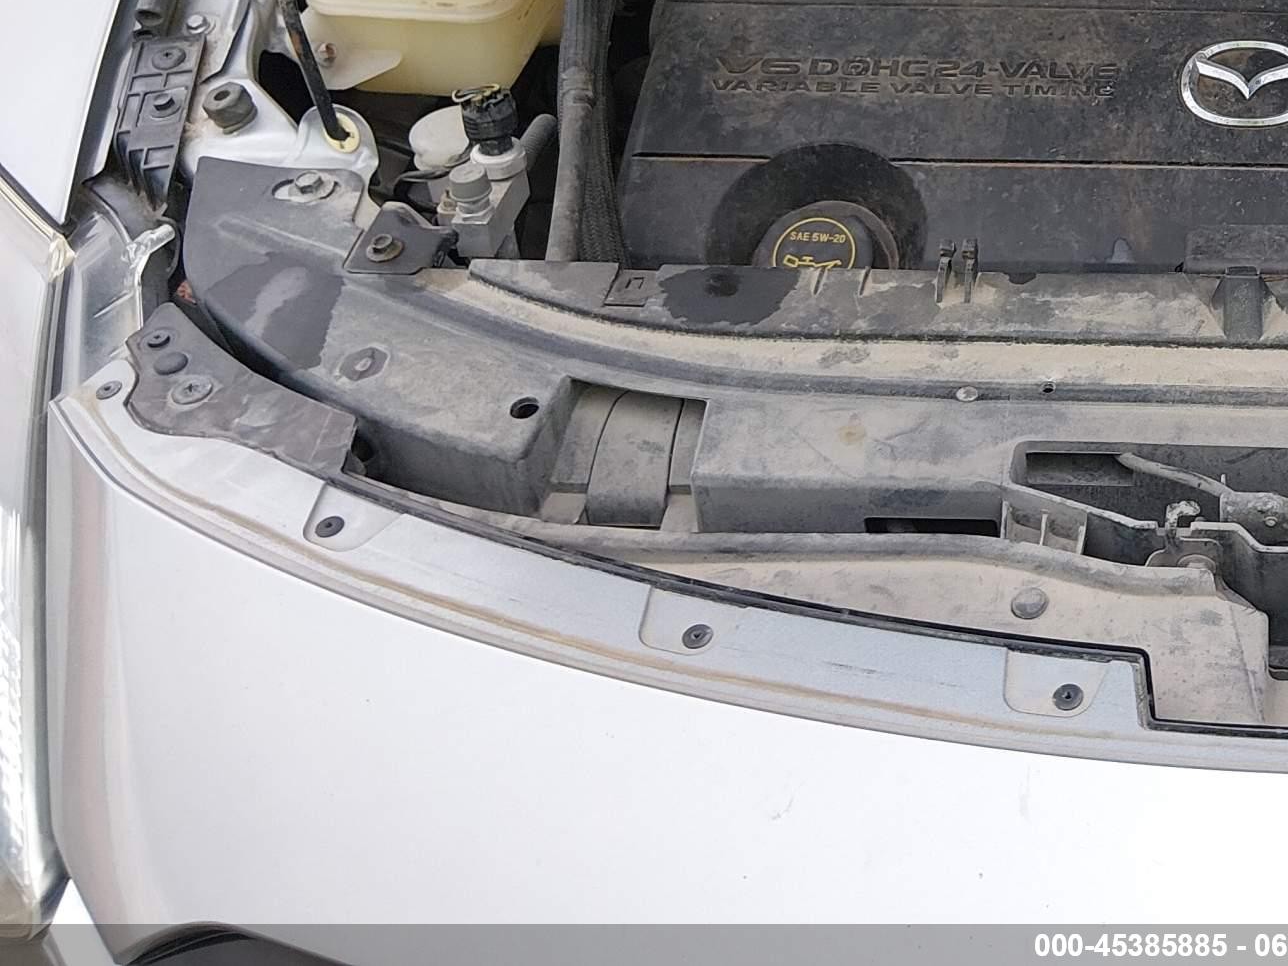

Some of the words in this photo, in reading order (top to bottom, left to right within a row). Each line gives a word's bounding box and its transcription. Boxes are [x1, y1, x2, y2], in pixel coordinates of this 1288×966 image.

[716, 57, 801, 75] V6
[808, 58, 928, 77] DOHC
[936, 59, 1121, 79] 24-VALVE
[712, 79, 880, 93] VARIABLE
[890, 82, 993, 95] VALVE
[790, 231, 810, 241] SAE
[812, 232, 846, 243] 5W-20
